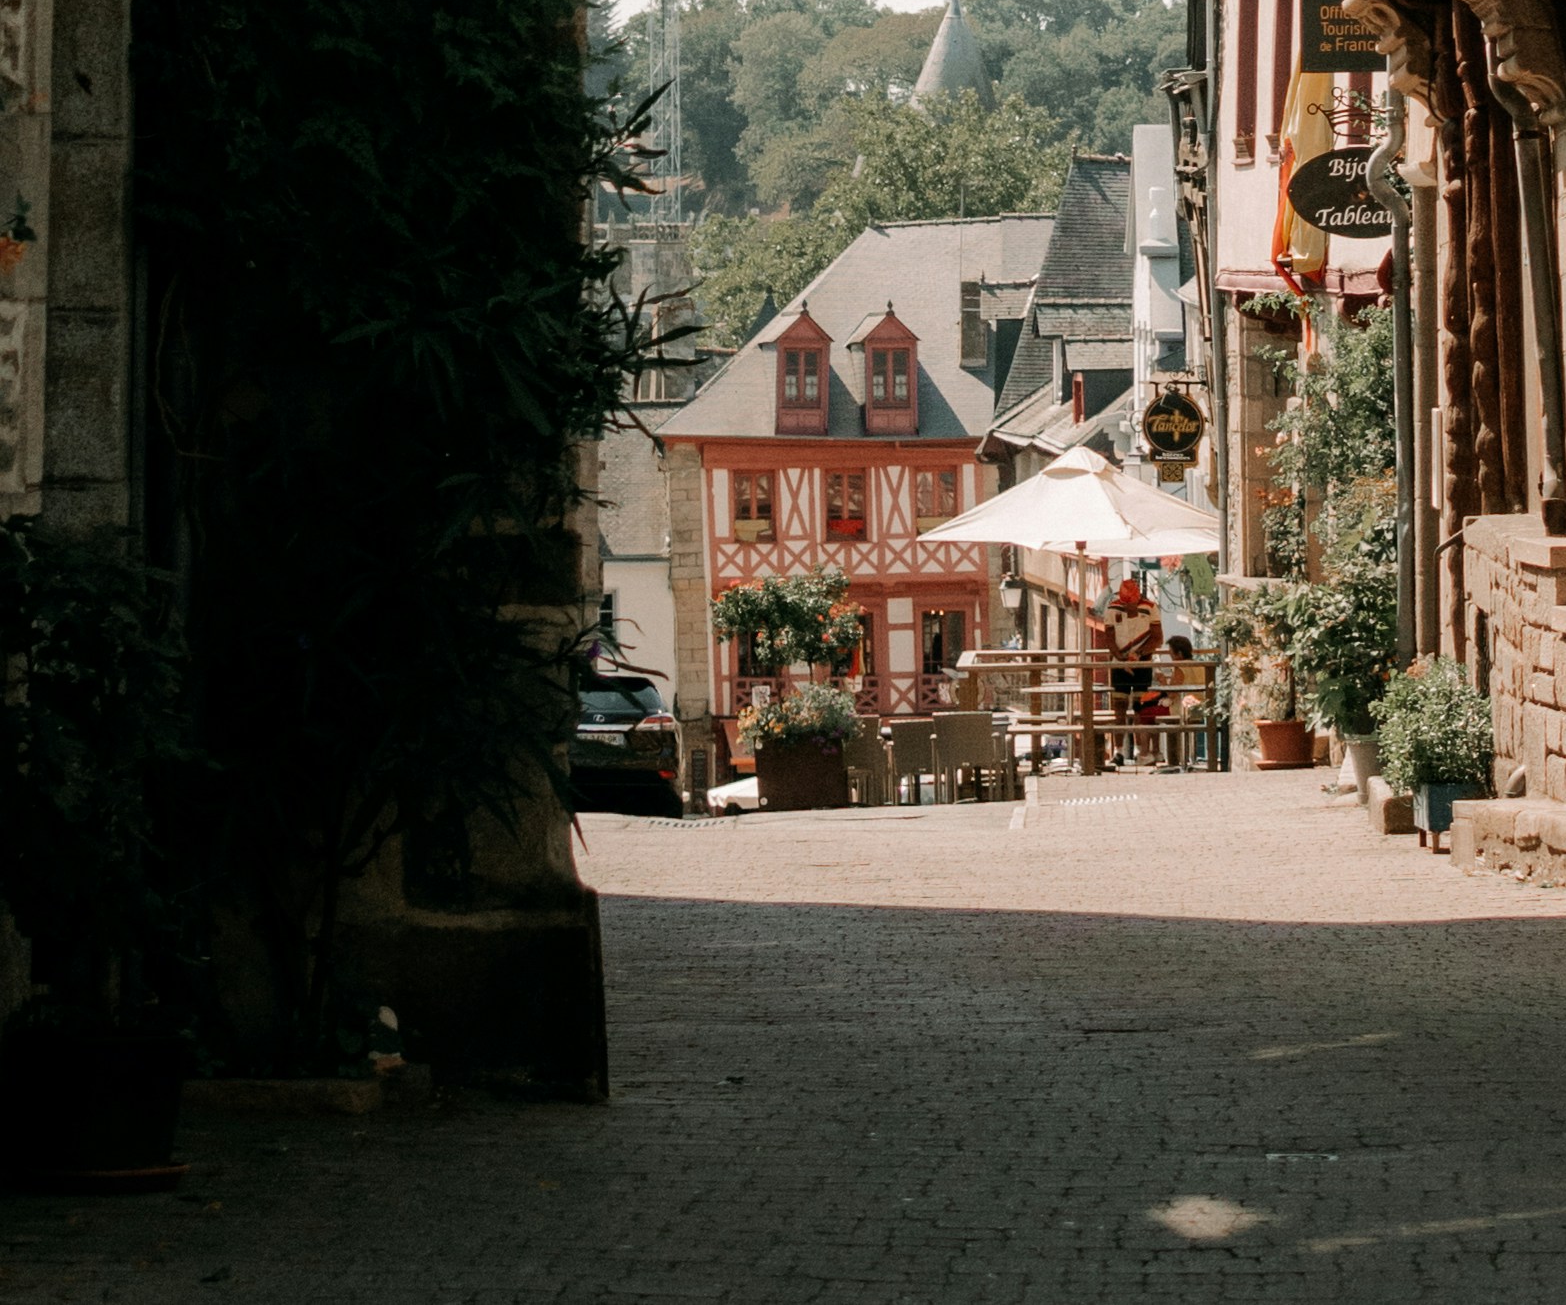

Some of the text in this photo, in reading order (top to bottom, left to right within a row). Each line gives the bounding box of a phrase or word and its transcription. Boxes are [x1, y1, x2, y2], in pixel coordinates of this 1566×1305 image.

[1319, 37, 1376, 52] de Franc
[1328, 156, 1397, 182] Bijox
